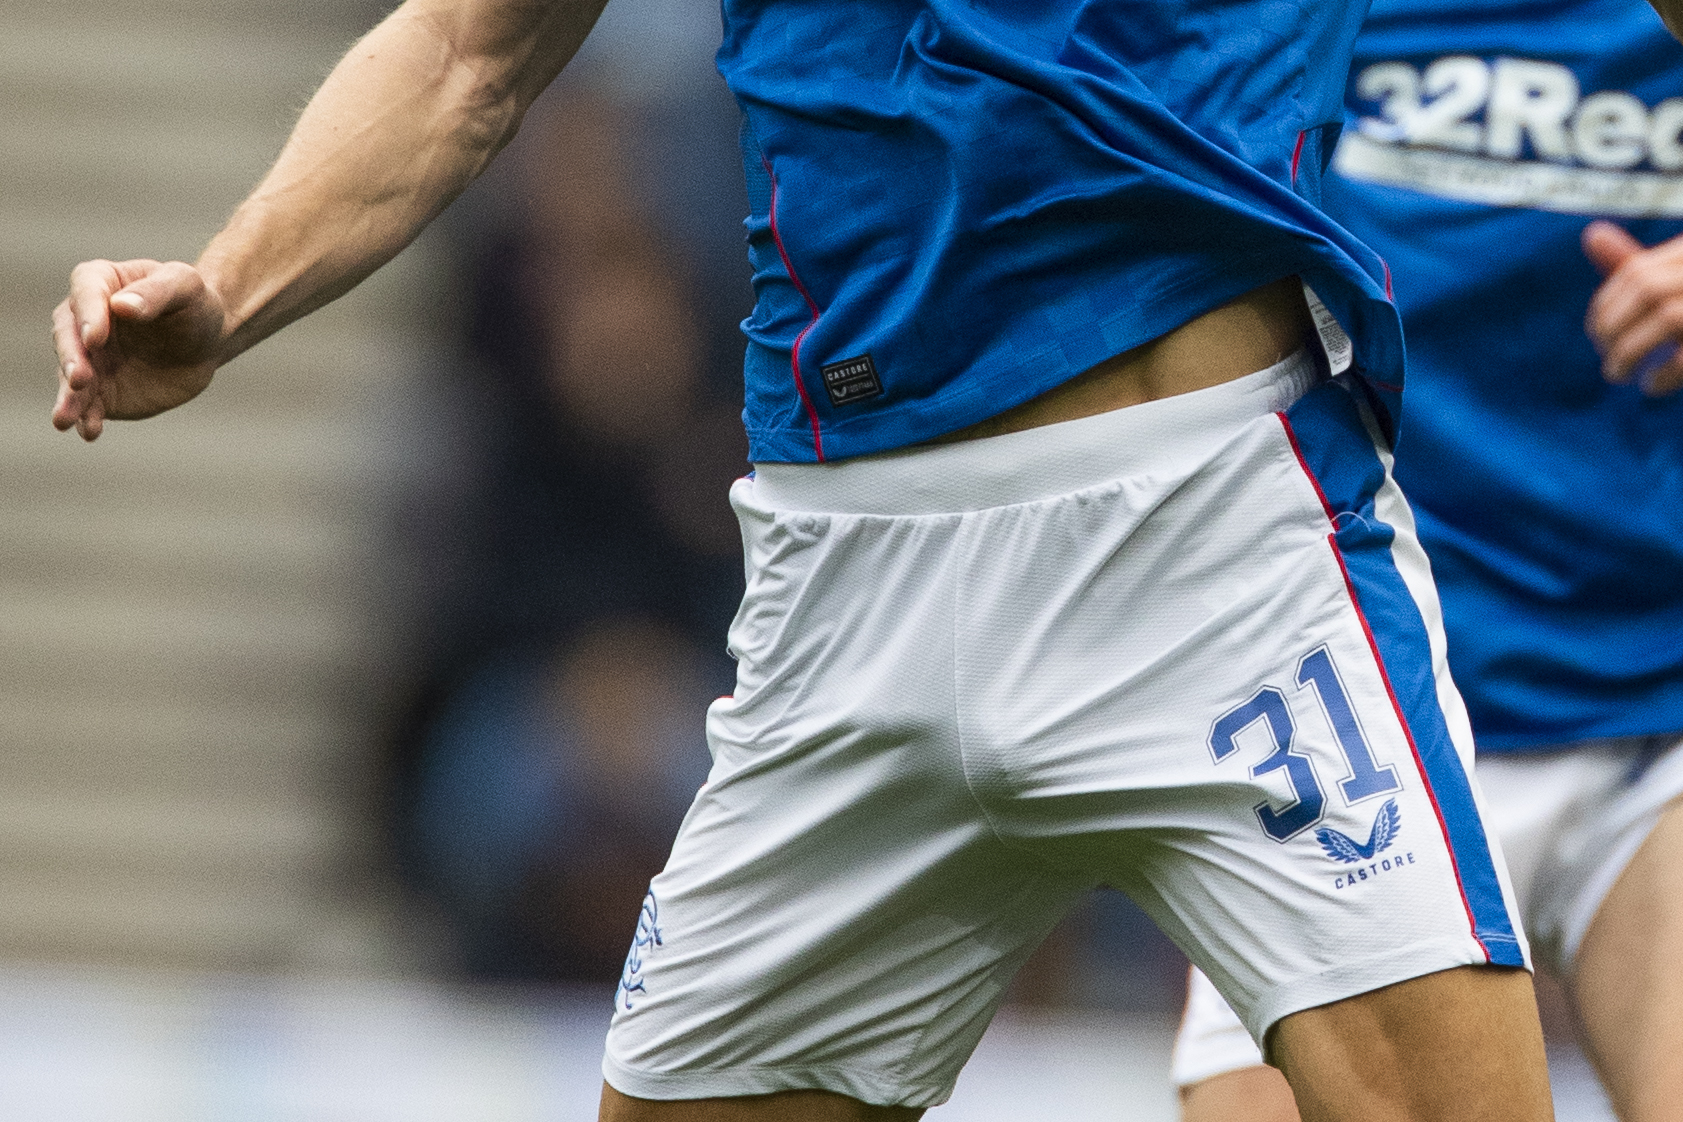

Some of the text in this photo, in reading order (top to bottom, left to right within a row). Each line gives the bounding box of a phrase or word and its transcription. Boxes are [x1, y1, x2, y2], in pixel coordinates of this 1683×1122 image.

[827, 363, 868, 382] CASTORE
[1206, 643, 1404, 845] 31
[1334, 851, 1417, 890] CASTORE
